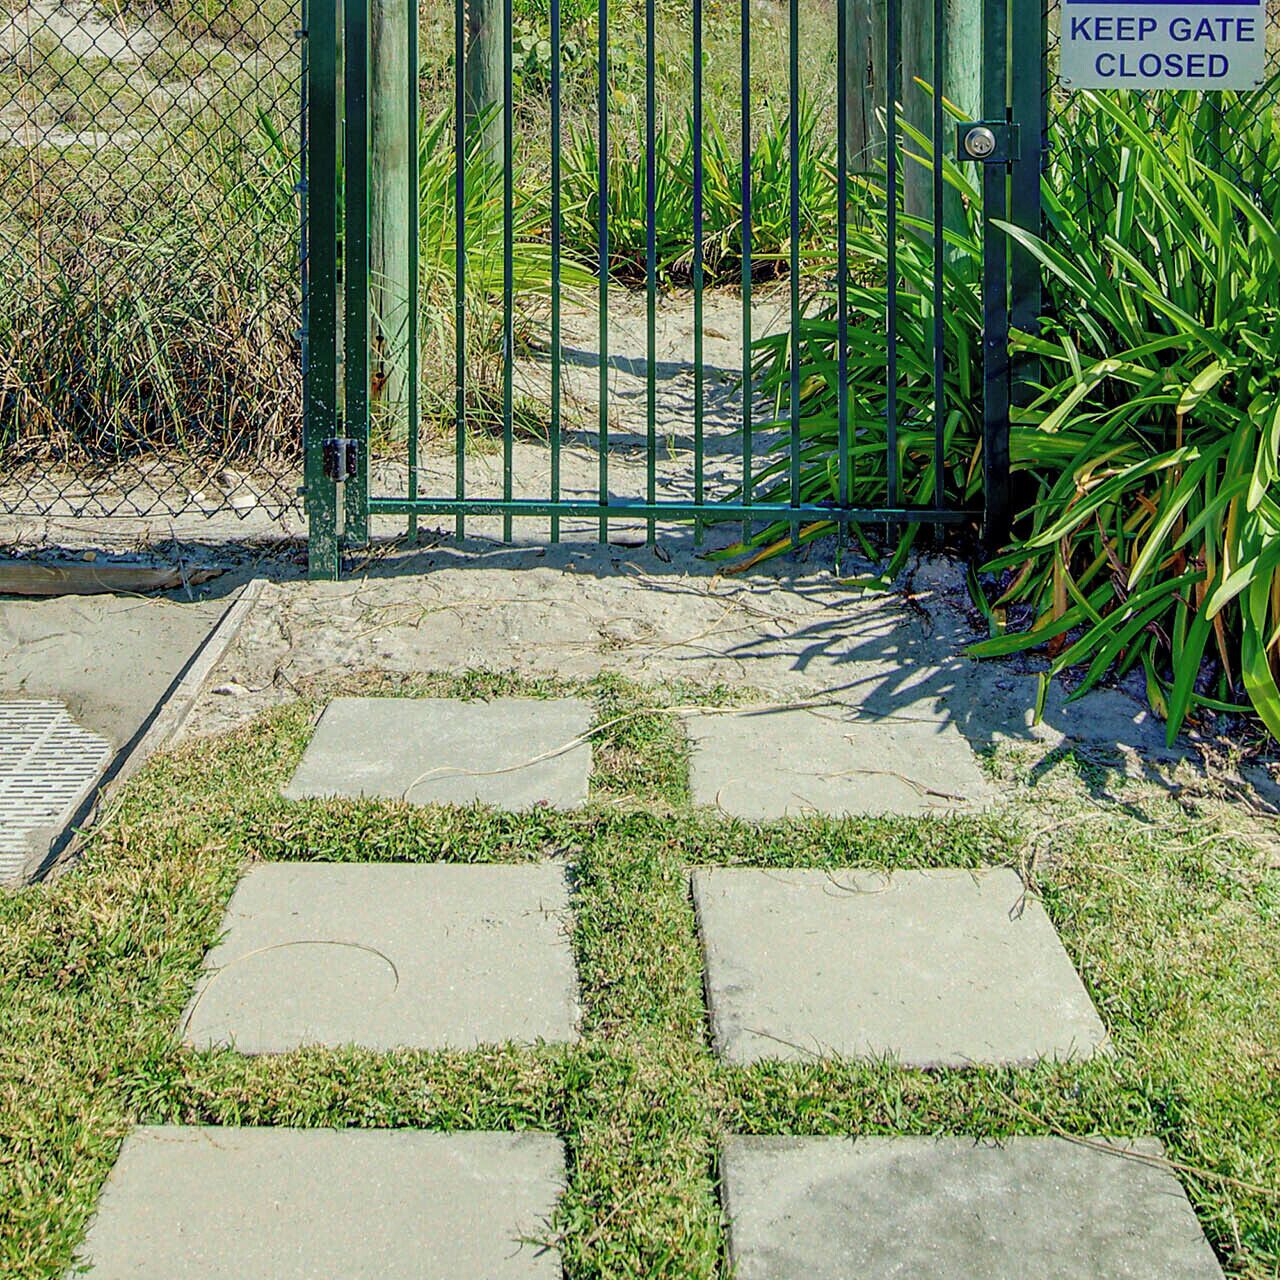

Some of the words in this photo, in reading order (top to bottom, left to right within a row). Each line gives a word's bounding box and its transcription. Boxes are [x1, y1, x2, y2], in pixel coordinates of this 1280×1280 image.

[1071, 17, 1158, 41] KEEP
[1169, 17, 1255, 42] GATE
[1095, 53, 1229, 78] CLOSED
